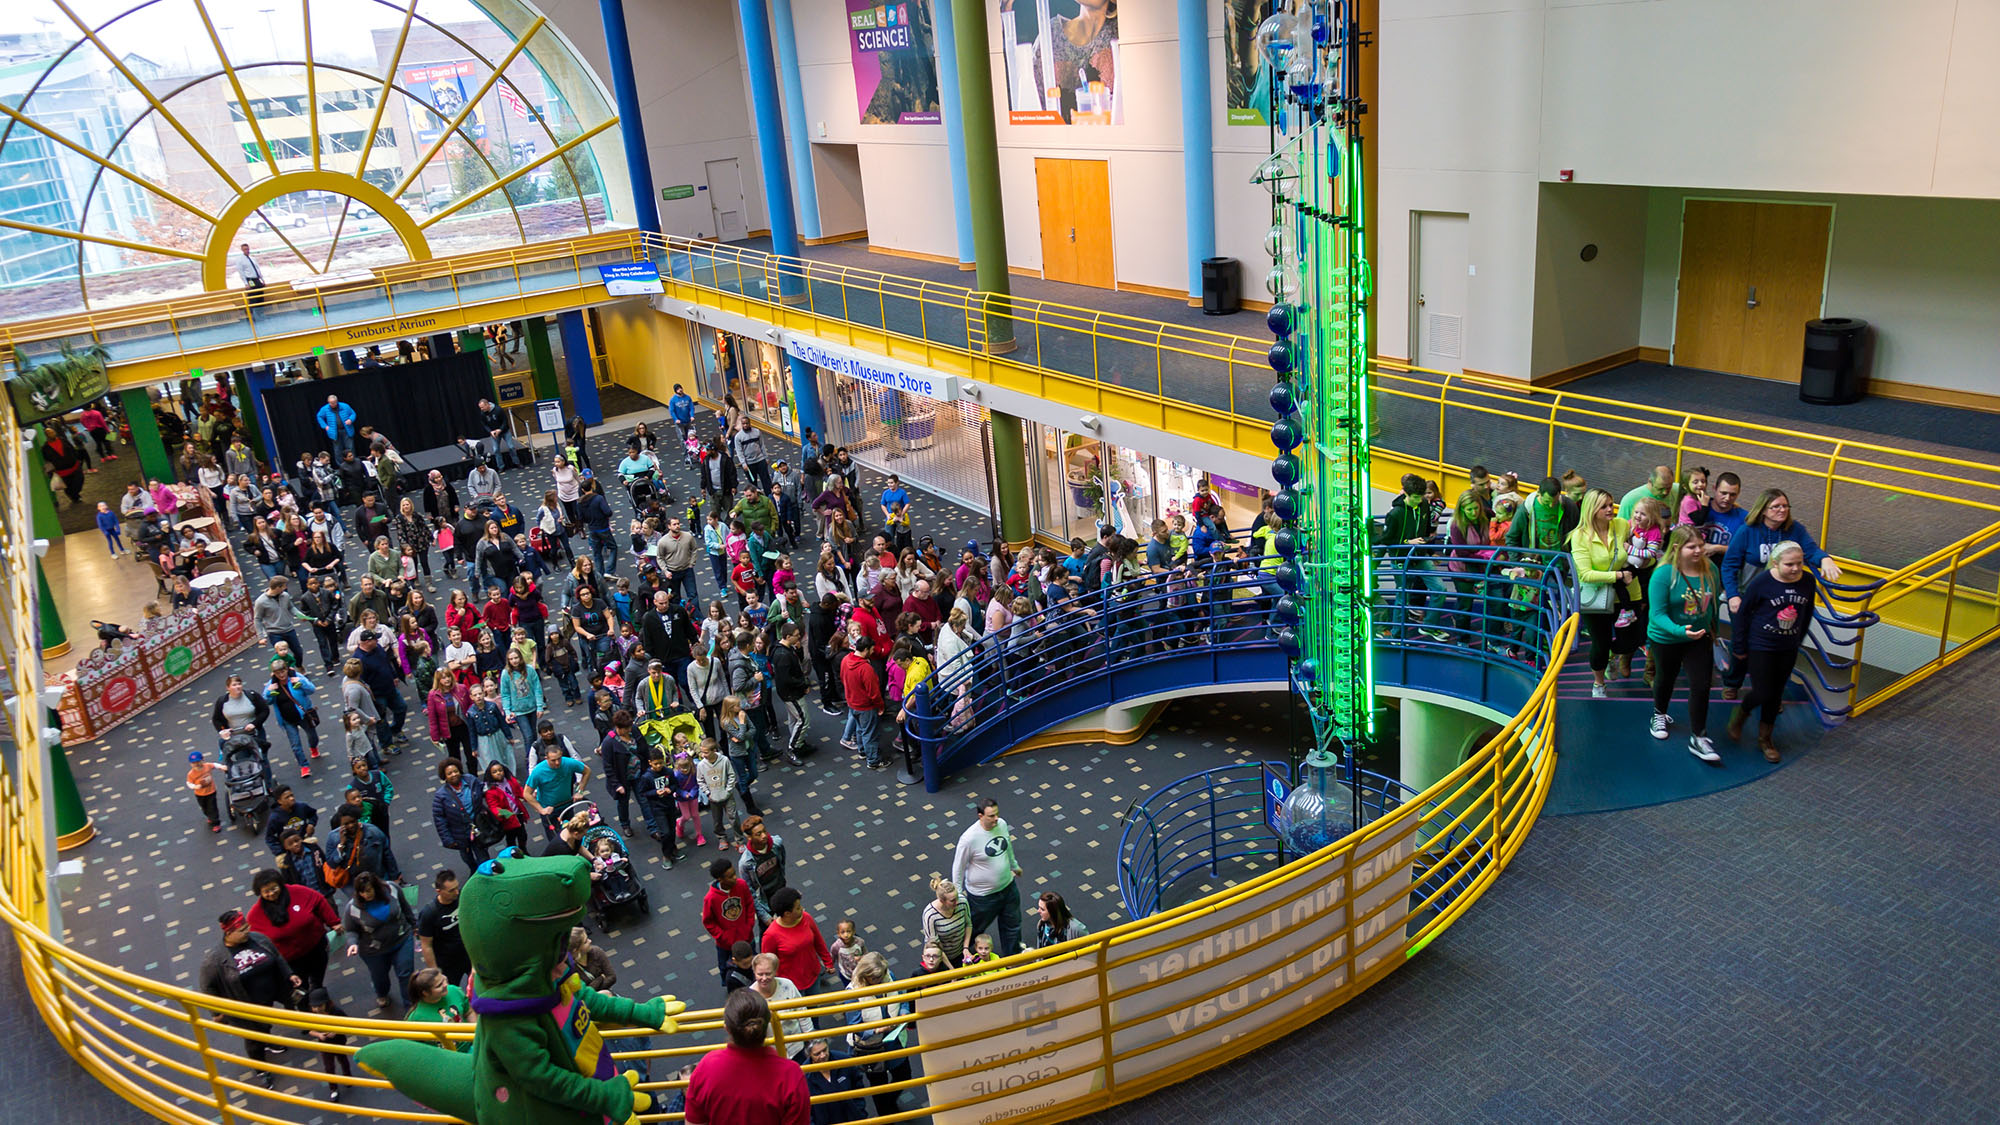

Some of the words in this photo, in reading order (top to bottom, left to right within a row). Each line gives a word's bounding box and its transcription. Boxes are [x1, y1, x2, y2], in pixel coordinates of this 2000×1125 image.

[852, 14, 875, 27] REAL
[859, 27, 909, 50] SCIENCE!
[346, 324, 397, 340] Sunburst
[399, 318, 436, 331] Atrium
[792, 341, 806, 359] The
[807, 346, 849, 374] Children's
[850, 360, 896, 386] Museum
[898, 372, 932, 395] Store
[986, 837, 1005, 856] Y
[574, 1000, 592, 1036] REX
